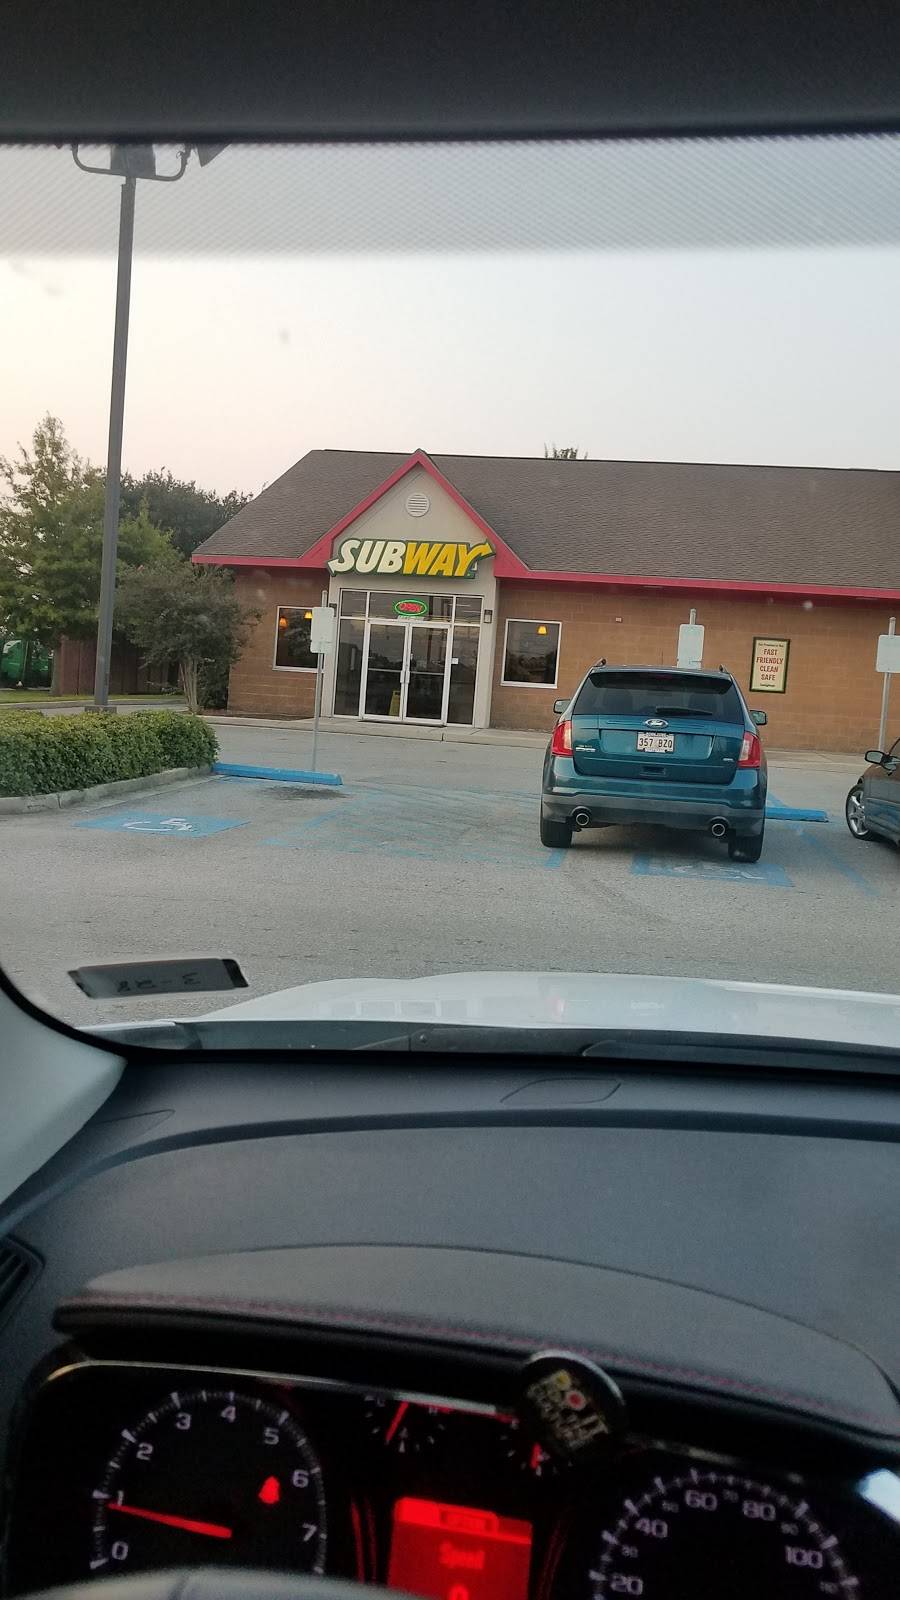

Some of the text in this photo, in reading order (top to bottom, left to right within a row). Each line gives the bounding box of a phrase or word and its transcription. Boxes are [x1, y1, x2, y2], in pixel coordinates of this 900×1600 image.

[327, 539, 493, 577] SUBWAY
[756, 656, 784, 665] FRIENDLY
[763, 648, 778, 656] FAST
[759, 665, 779, 673] CLEAN
[760, 673, 776, 681] SAFE
[638, 737, 654, 747] 357
[175, 1412, 192, 1431] 3
[220, 1405, 237, 1423] 4
[263, 1427, 280, 1446] 5
[136, 1442, 154, 1461] 2
[292, 1469, 310, 1488] 6
[684, 1489, 718, 1512] 60
[742, 1499, 776, 1522] 80
[302, 1523, 317, 1542] 7
[634, 1518, 669, 1539] 40
[112, 1541, 129, 1561] 0
[784, 1546, 824, 1570] 100
[610, 1574, 644, 1597] 20
